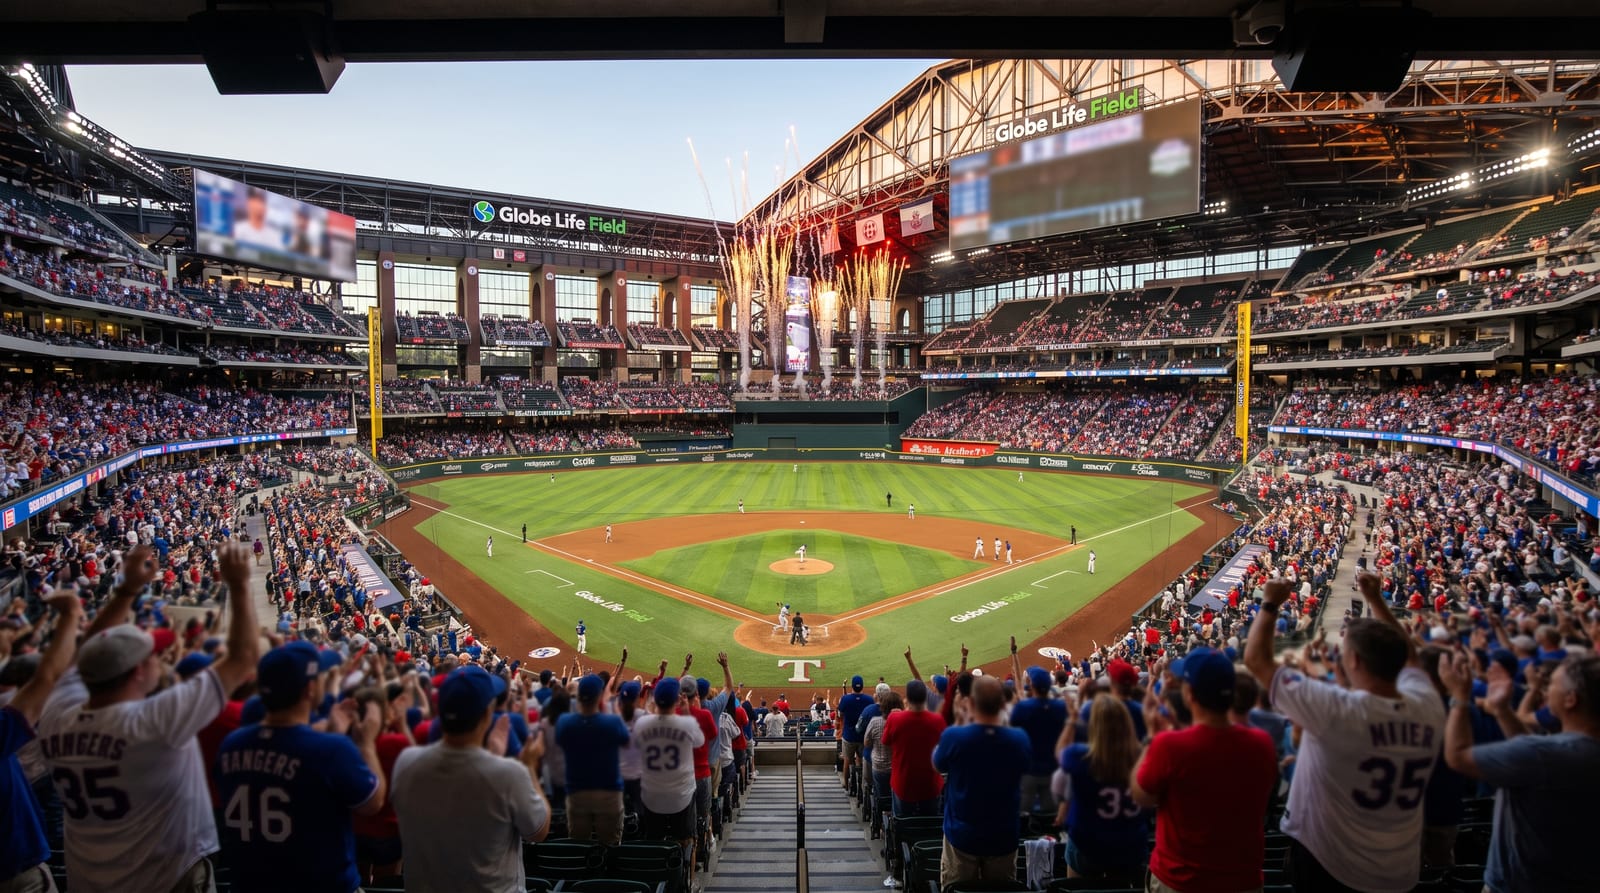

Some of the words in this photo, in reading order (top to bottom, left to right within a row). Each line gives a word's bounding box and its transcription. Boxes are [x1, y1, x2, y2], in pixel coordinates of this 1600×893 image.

[995, 118, 1048, 143] Globe
[1052, 104, 1087, 129] Life
[1091, 87, 1139, 119] Field
[499, 206, 552, 226] Globe
[555, 212, 586, 230] Life
[589, 216, 627, 235] Field
[949, 608, 990, 623] Globe
[777, 659, 825, 684] T
[221, 747, 301, 781] RANGERS
[646, 743, 681, 772] 23
[52, 765, 132, 822] 35
[1352, 755, 1434, 811] 35
[223, 783, 292, 843] 46
